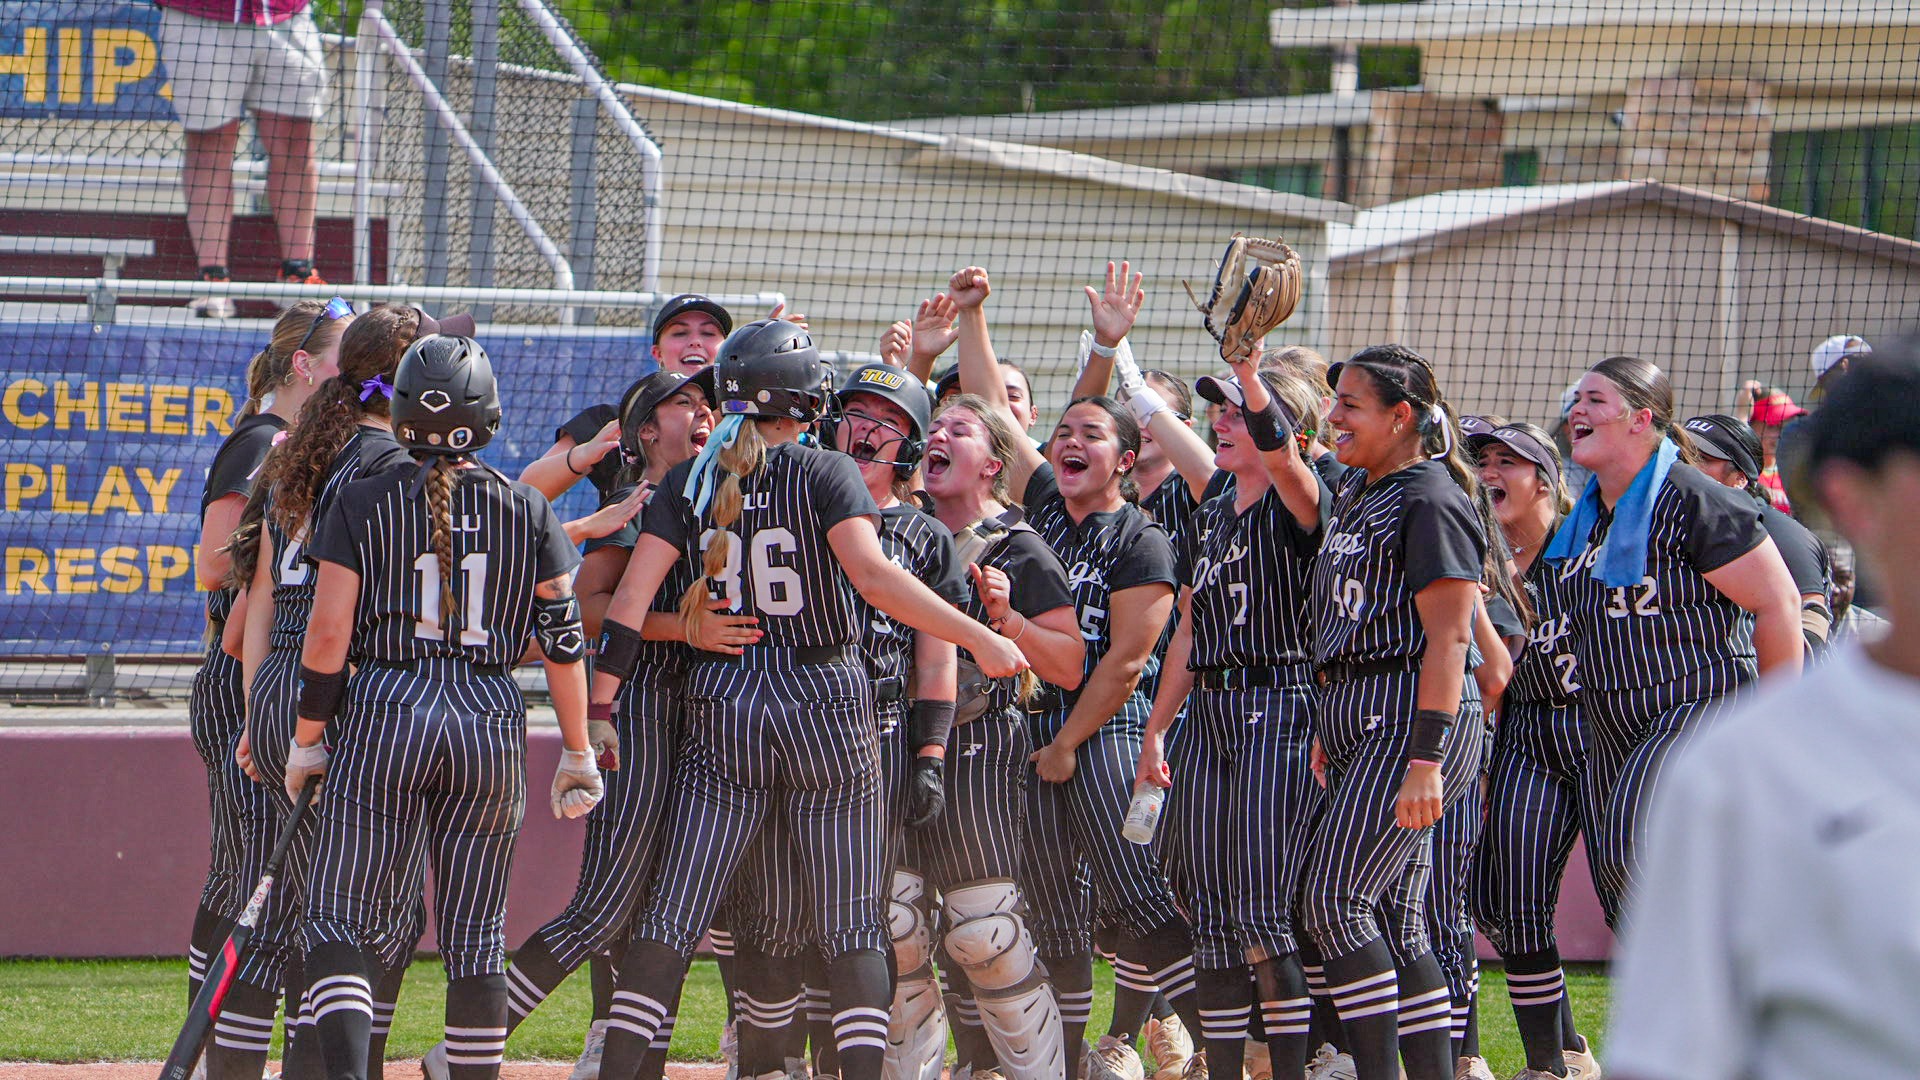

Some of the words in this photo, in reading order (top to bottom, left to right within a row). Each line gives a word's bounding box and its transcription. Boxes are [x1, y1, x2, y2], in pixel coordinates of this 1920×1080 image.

[0, 28, 173, 104] HIP
[726, 380, 739, 393] 36
[858, 368, 905, 390] TLU
[2, 378, 234, 437] CHEER
[1685, 420, 1714, 432] TLU
[5, 463, 182, 515] PLAY
[741, 491, 770, 510] LU
[428, 514, 481, 532] LU
[699, 526, 805, 616] 36
[1192, 542, 1249, 595] Dos
[414, 552, 489, 646] 11
[1228, 582, 1248, 625] 7
[1607, 575, 1660, 619] 32
[1554, 653, 1582, 694] 2
